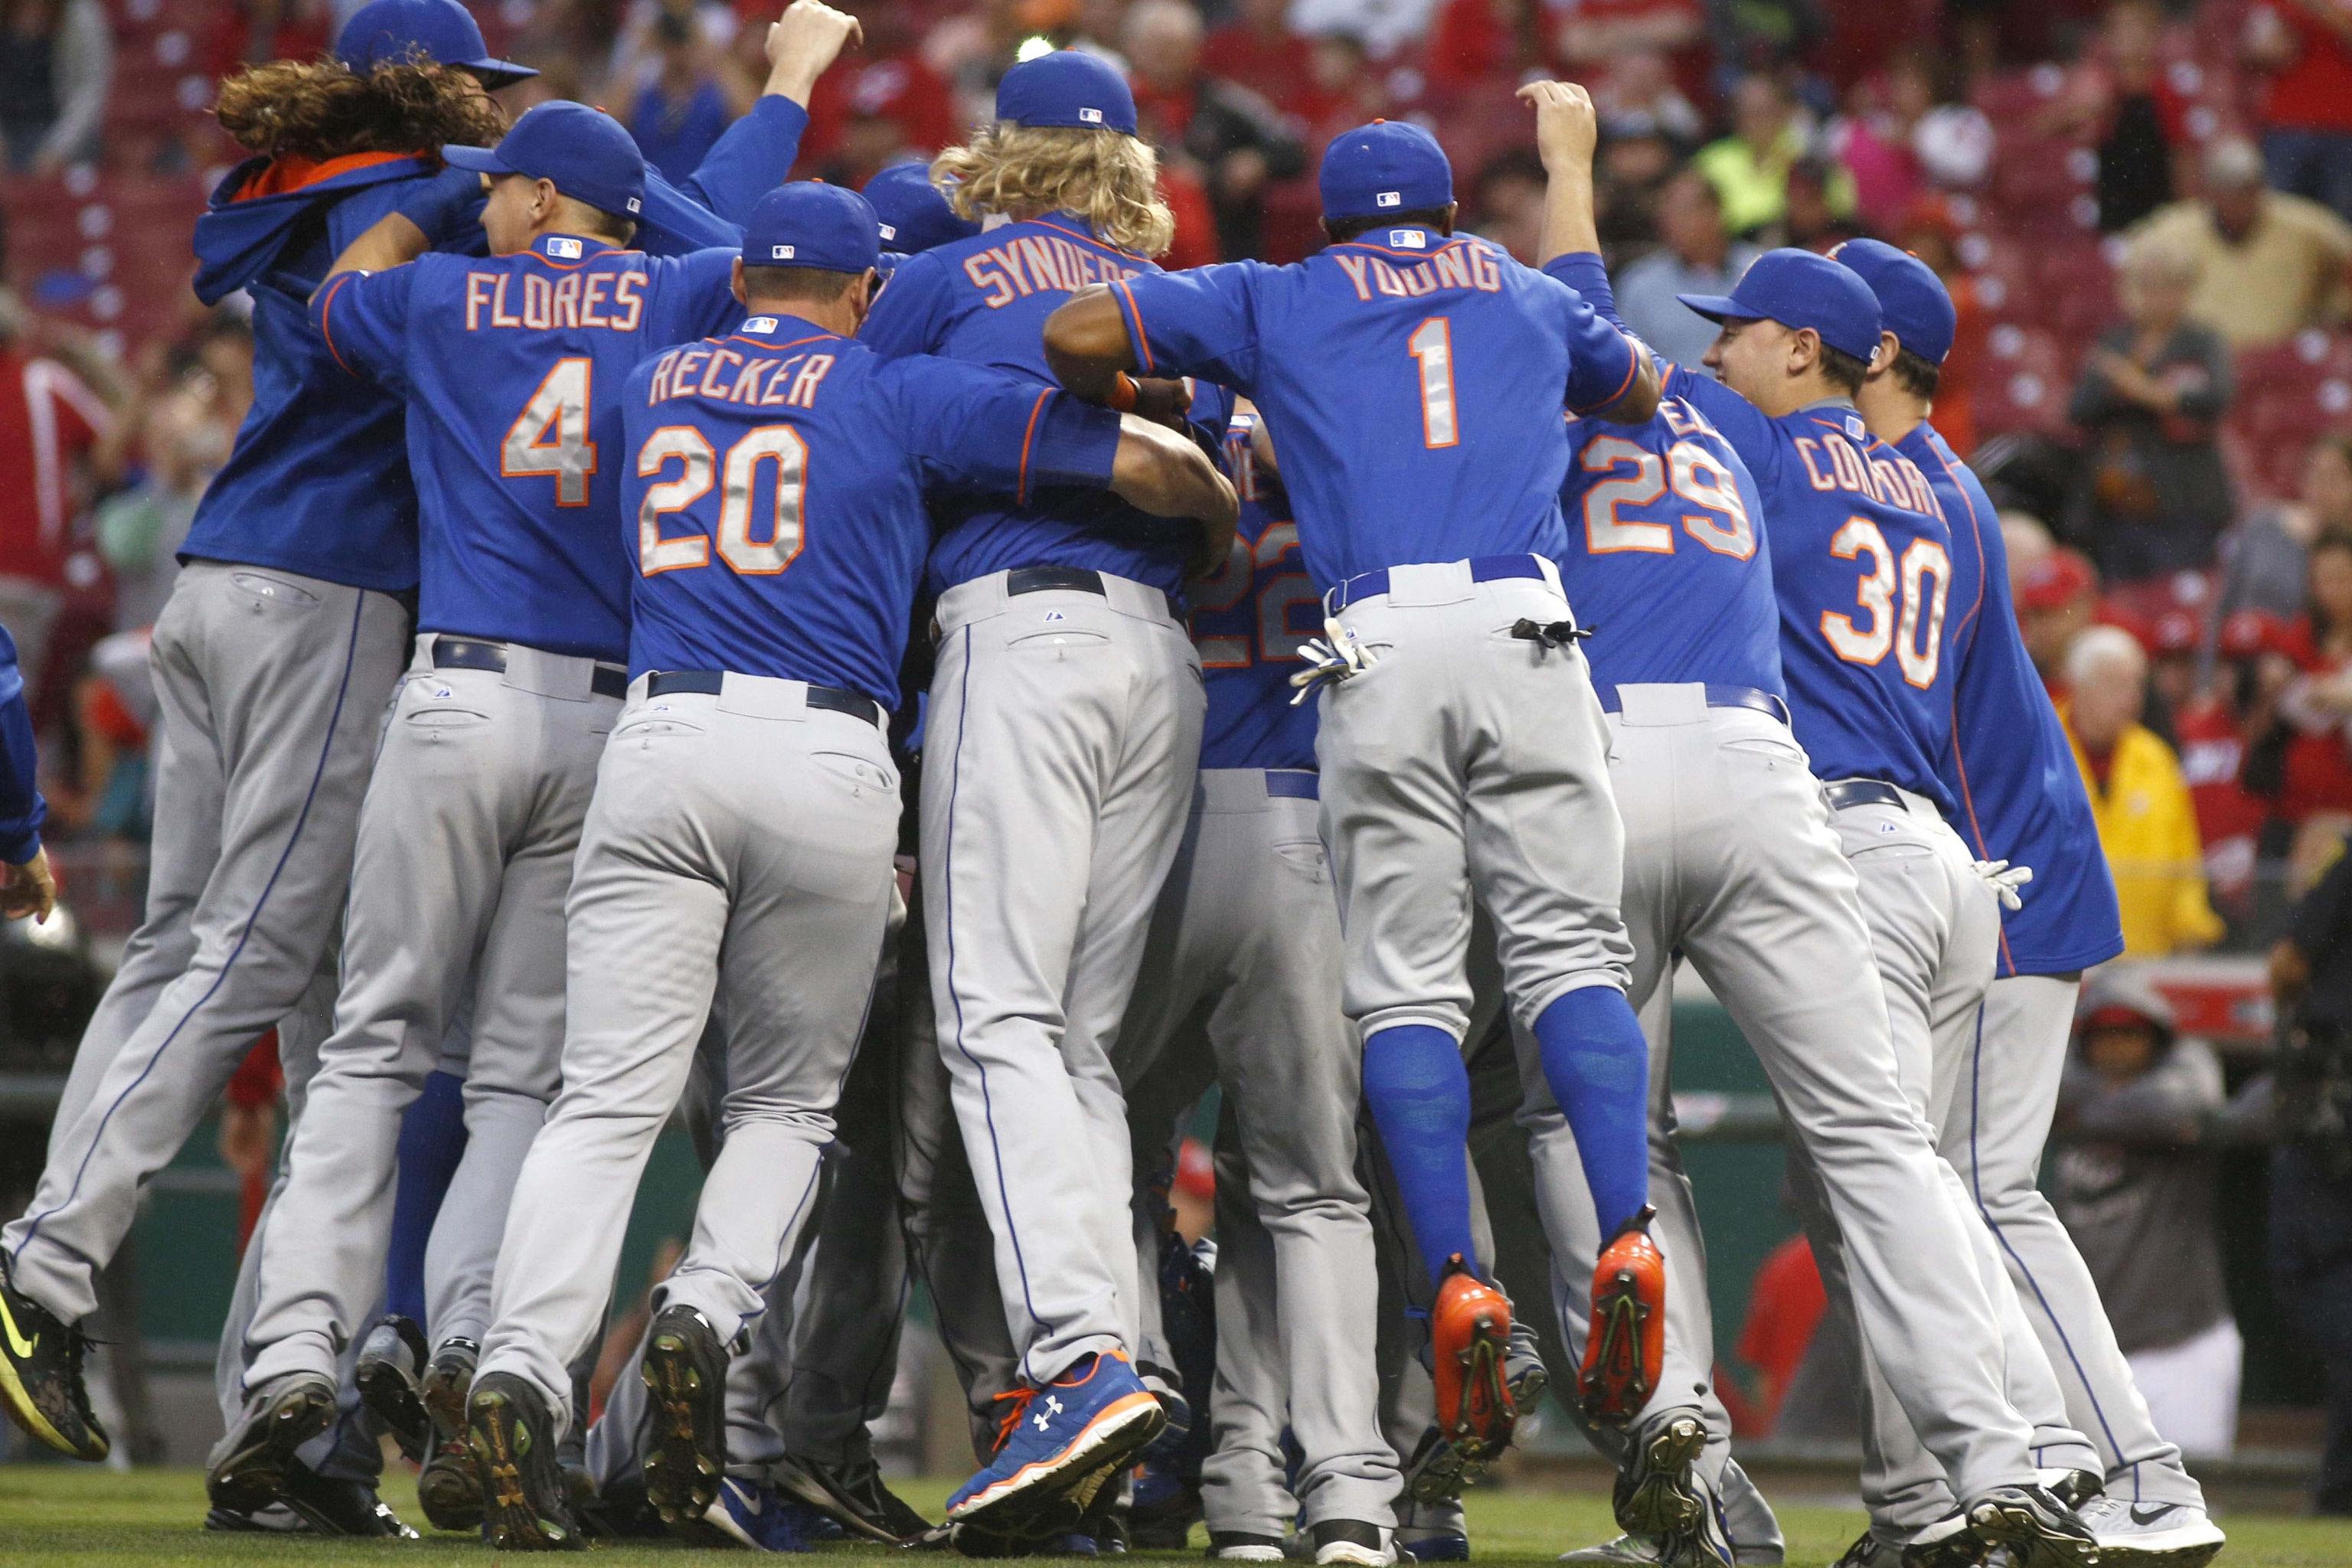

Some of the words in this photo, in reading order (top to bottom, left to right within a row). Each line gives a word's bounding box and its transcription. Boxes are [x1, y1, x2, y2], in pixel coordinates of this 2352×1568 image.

[466, 272, 648, 332] FLORES
[964, 235, 1141, 309] SYNDER
[1334, 238, 1502, 301] YOUNG
[501, 357, 598, 507] 4
[649, 349, 835, 409] RECKER
[1406, 316, 1460, 449] 1
[637, 424, 809, 578] 20
[1579, 434, 1756, 562] 29
[1819, 514, 1952, 691] 30
